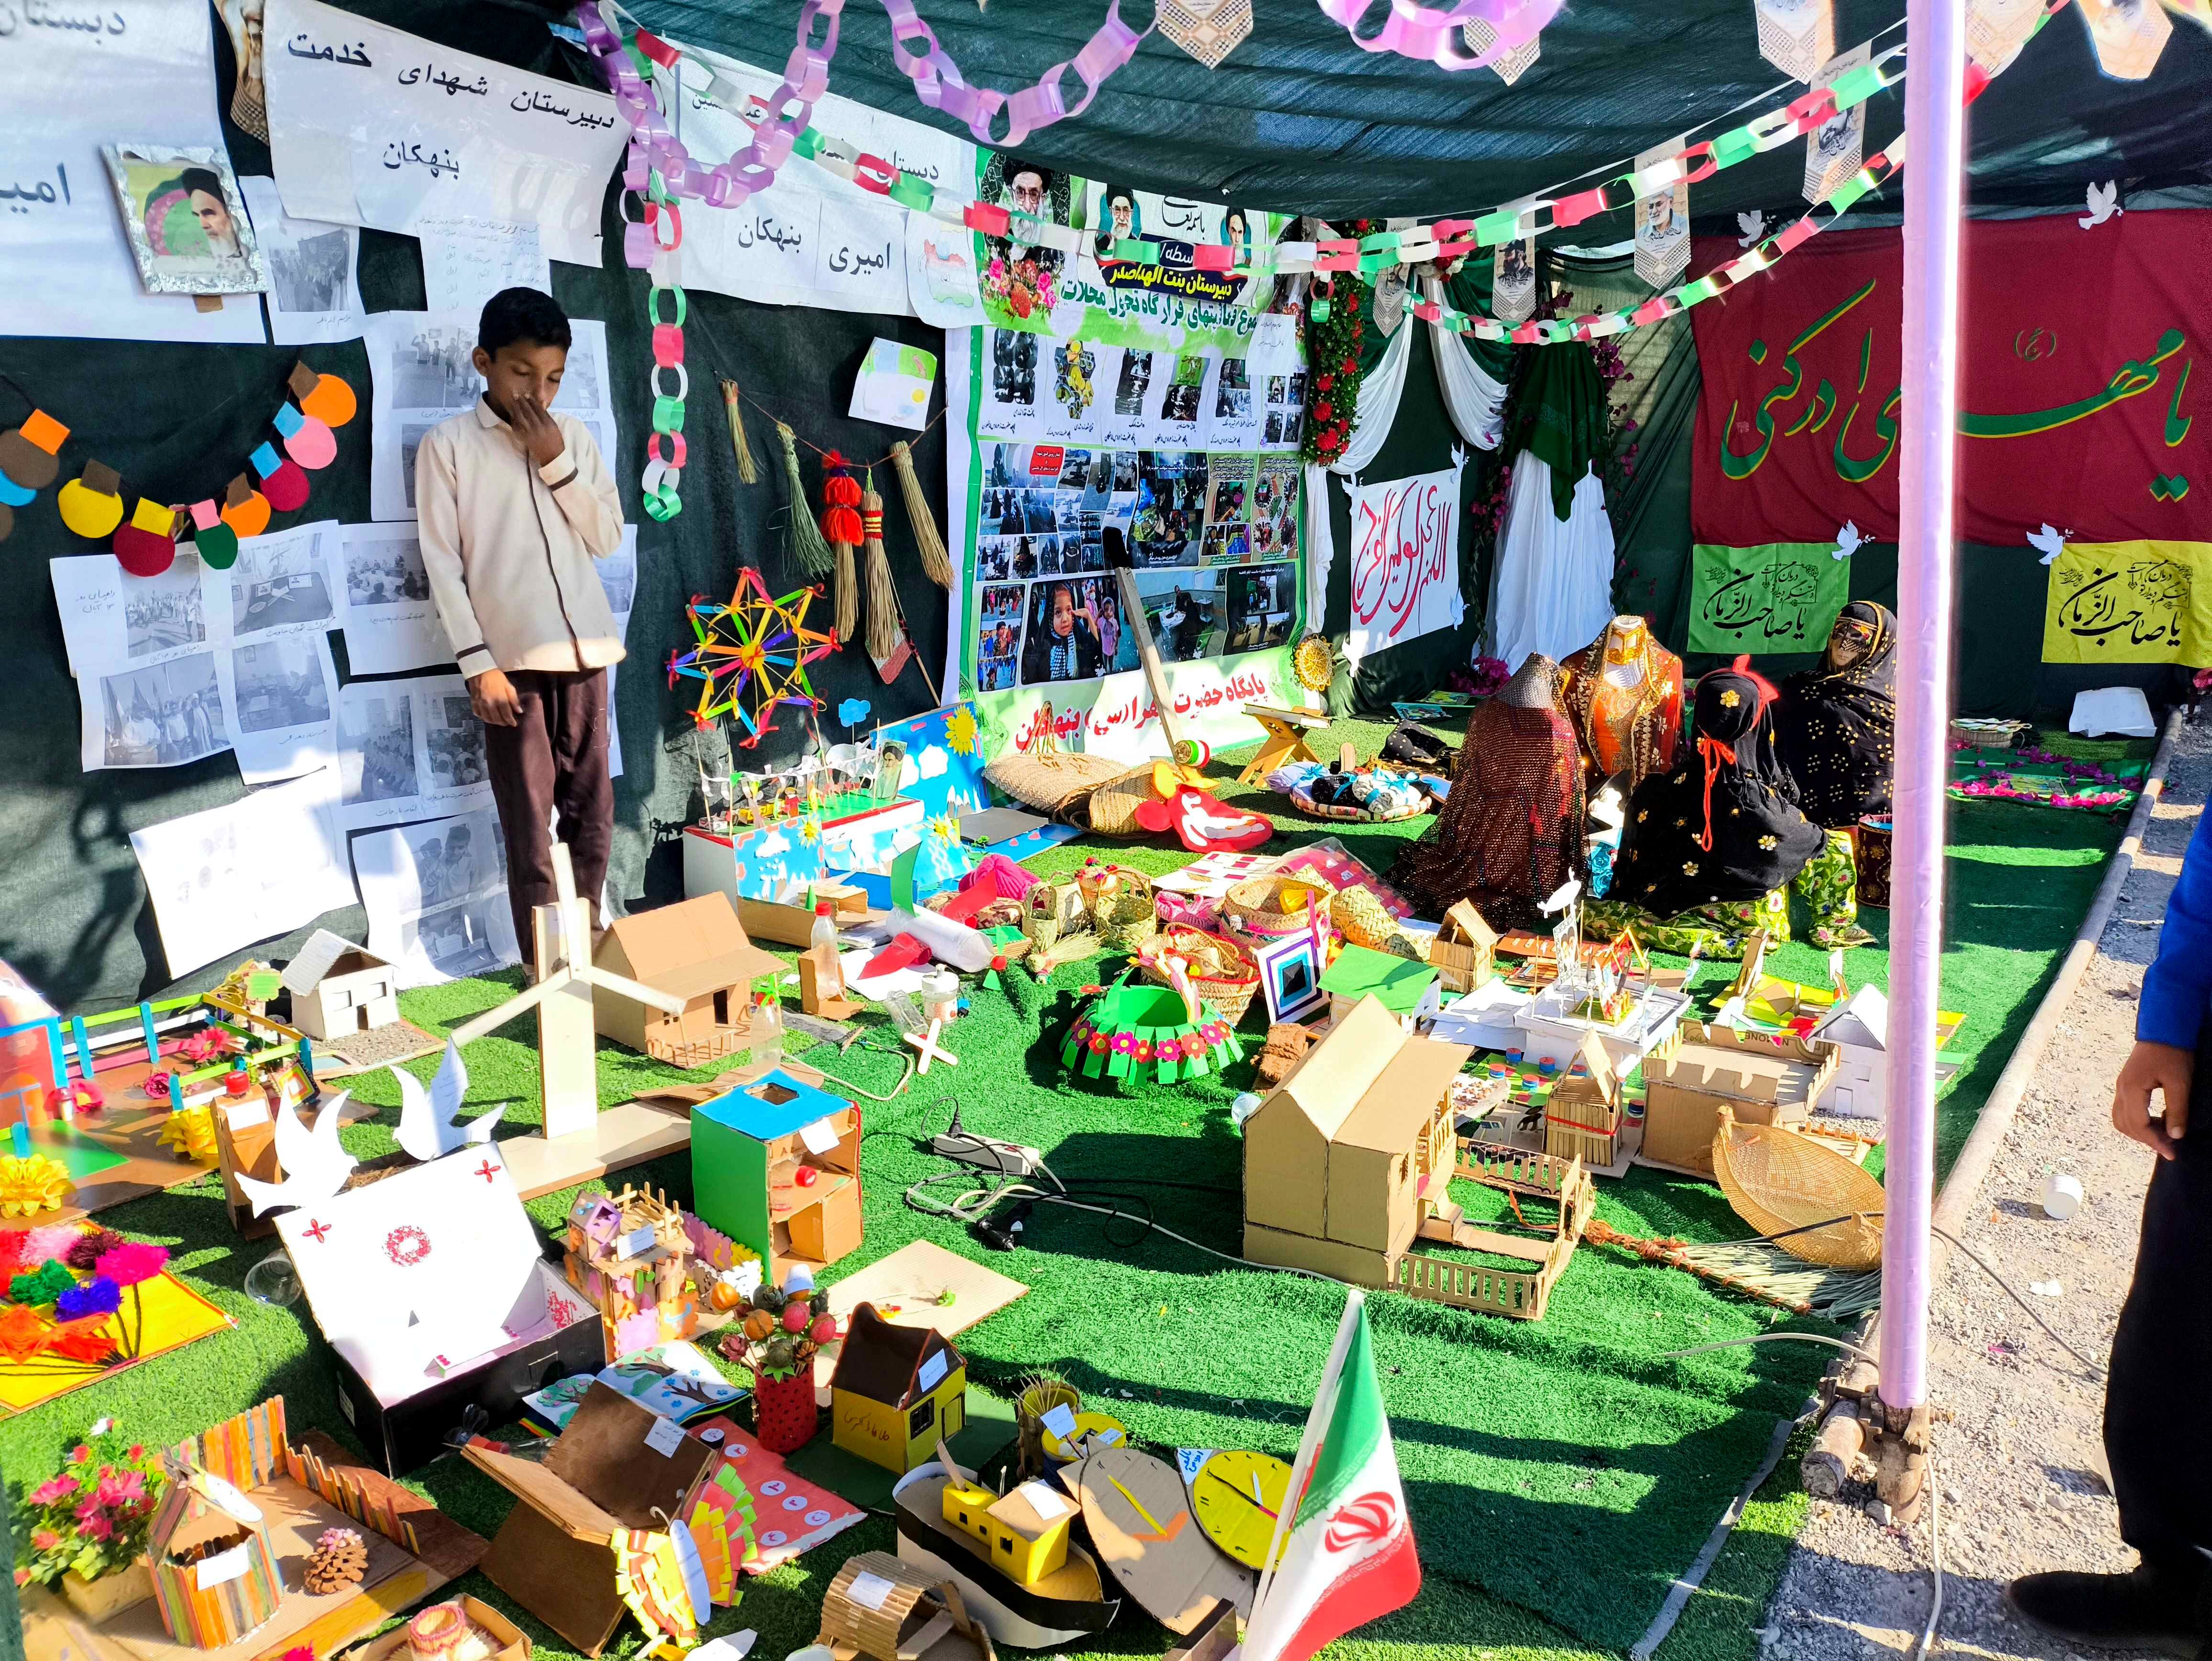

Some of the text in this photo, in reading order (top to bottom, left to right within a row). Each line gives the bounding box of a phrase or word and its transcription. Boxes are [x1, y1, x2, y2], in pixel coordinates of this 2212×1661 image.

[288, 34, 615, 129] دبیرستان شهدای خدمت
[383, 141, 460, 178] بنهکان
[738, 216, 890, 275] امیری بنهکان
[1061, 280, 1106, 307] محلات
[1163, 269, 1186, 292] بنت
[1186, 274, 1232, 301] دبیرستان
[1109, 288, 1139, 317] تحول
[1141, 292, 1159, 315] گاه
[1720, 277, 1875, 480] ادرکنی
[2149, 358, 2192, 503] یا
[1352, 488, 1397, 614] الفرج
[1418, 501, 1452, 635] اللهم
[1714, 607, 1793, 640] صاحب
[1793, 607, 1807, 640] یا
[2070, 610, 2167, 647] صاحب
[2167, 611, 2182, 647] یا
[1173, 684, 1223, 718] حضرت
[1227, 673, 1269, 702] پایگاه
[1134, 696, 1161, 729] هرا
